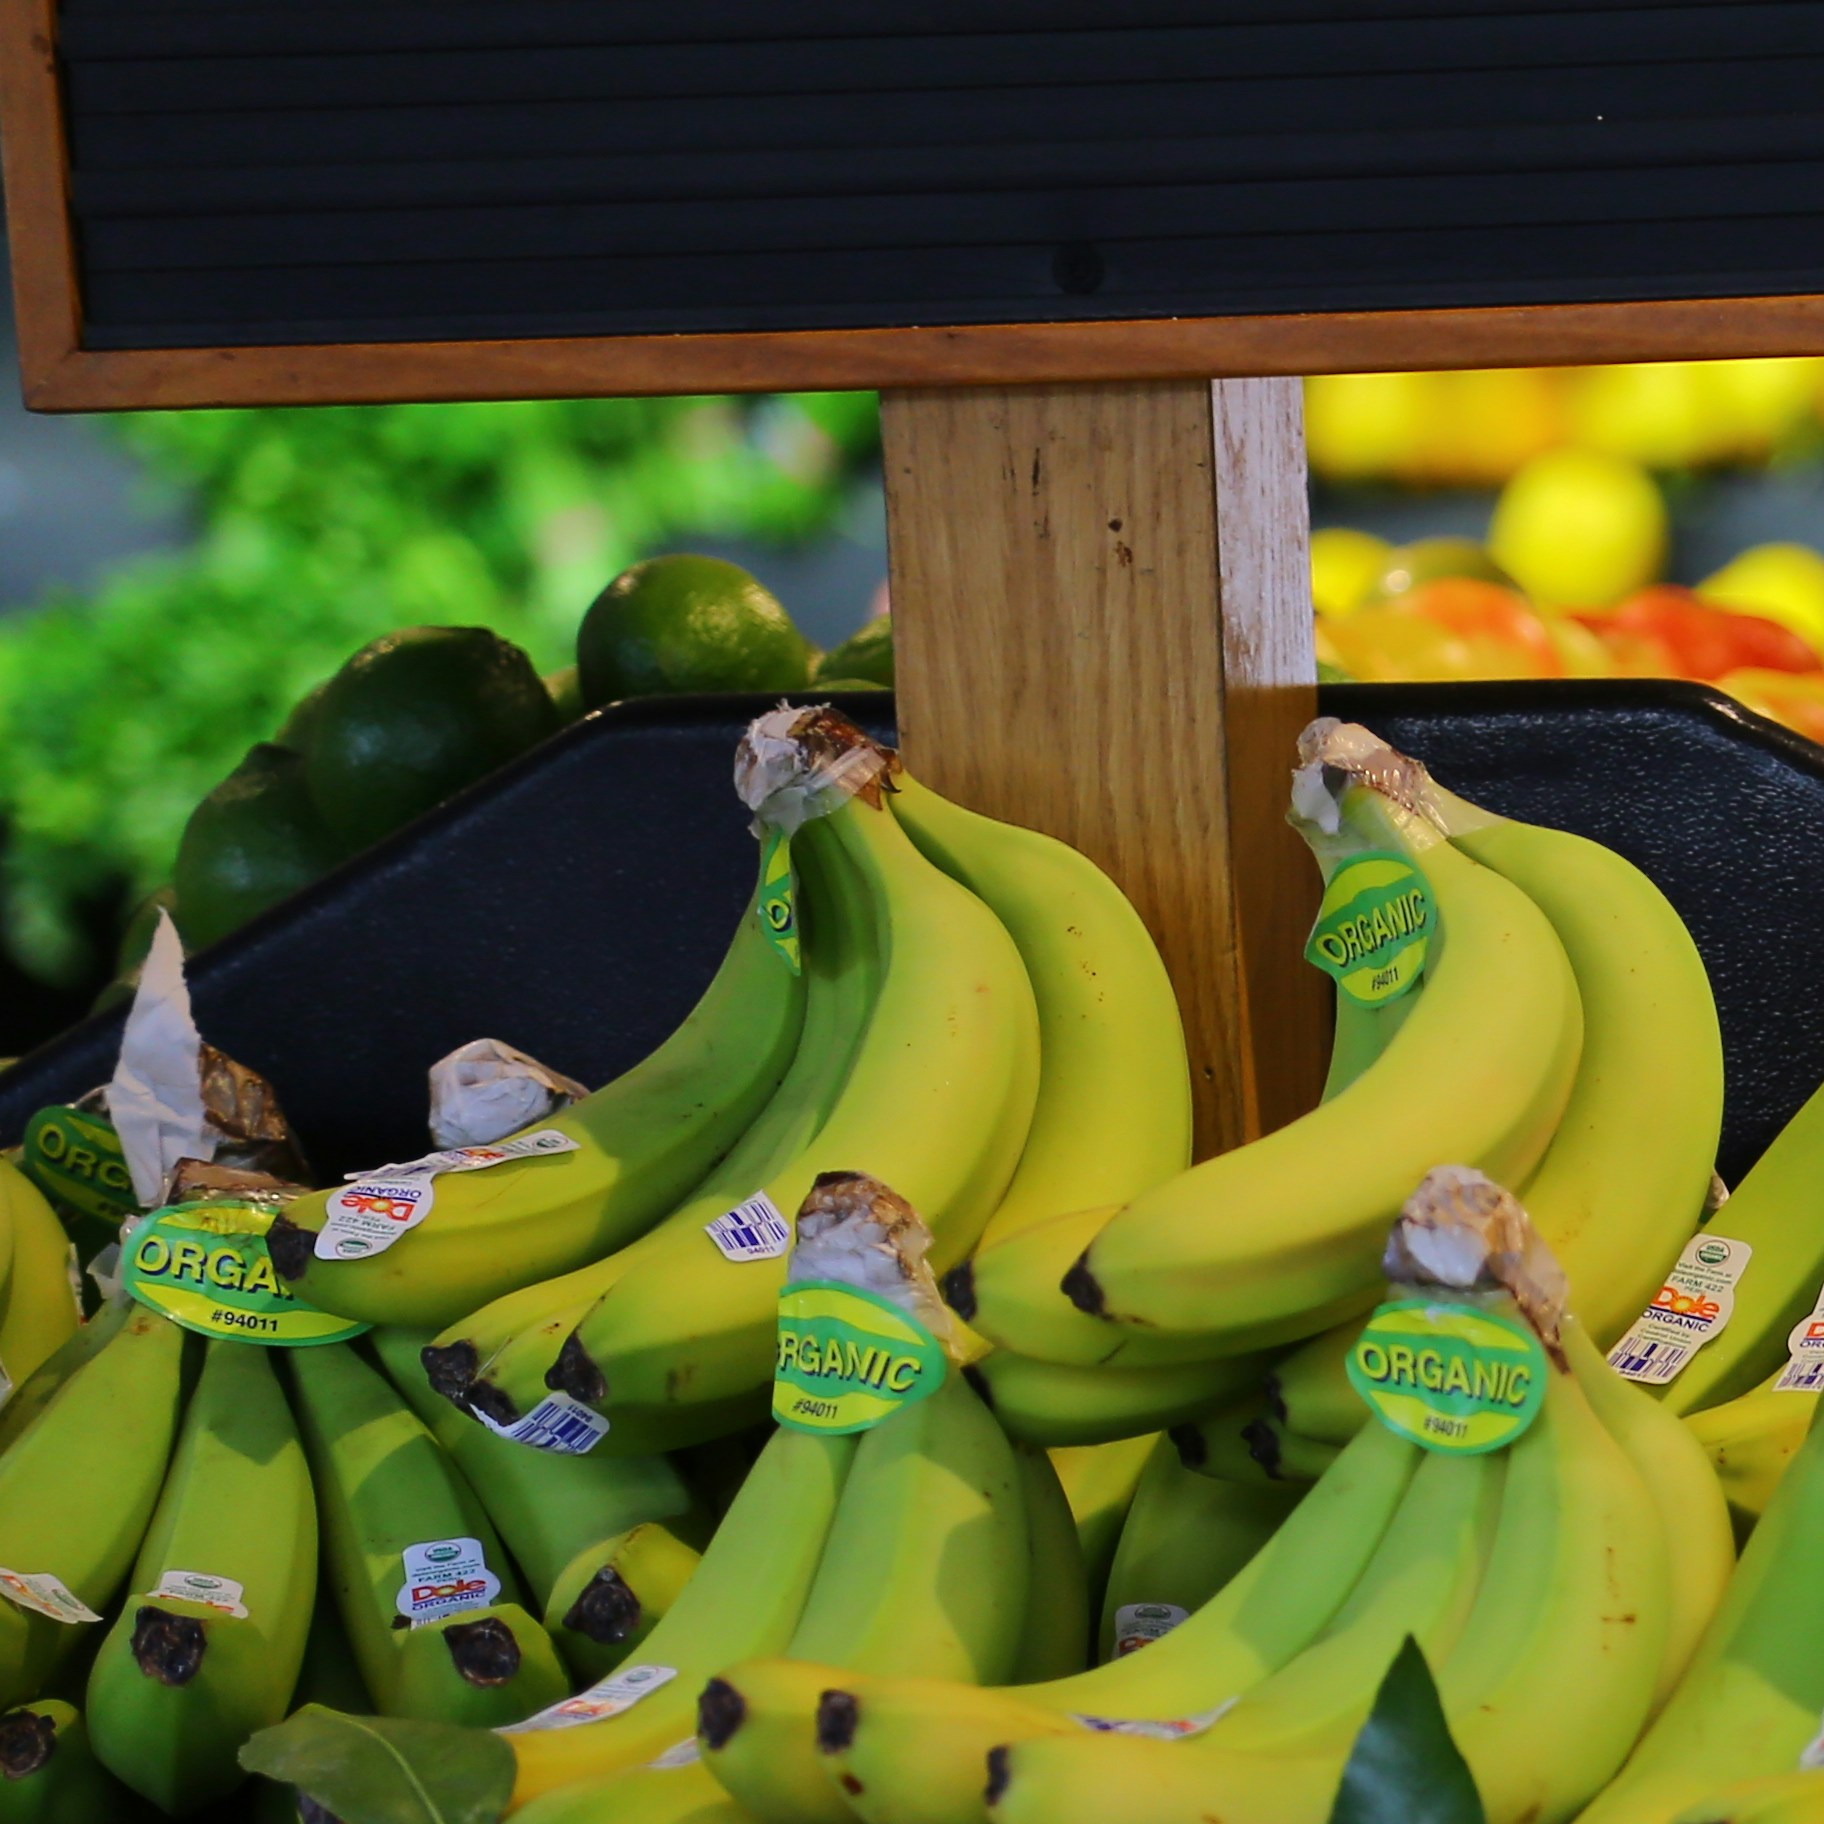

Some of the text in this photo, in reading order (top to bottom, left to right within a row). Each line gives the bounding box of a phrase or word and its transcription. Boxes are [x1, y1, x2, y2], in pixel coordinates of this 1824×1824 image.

[1315, 888, 1428, 968] ORGANIC
[1371, 966, 1400, 991] #94011
[340, 1194, 417, 1222] Dole
[134, 1235, 294, 1300] ORGA
[1671, 1275, 1725, 1293] FARM 422
[1651, 1286, 1720, 1320] Dole
[211, 1309, 279, 1333] #94011
[1641, 1310, 1711, 1333] ORGANIC
[777, 1330, 923, 1394] RGANIC
[1356, 1341, 1532, 1408] ORGANIC
[792, 1398, 839, 1420] #94011
[411, 1579, 487, 1602] Dole
[411, 1591, 487, 1611] ORGANIC
